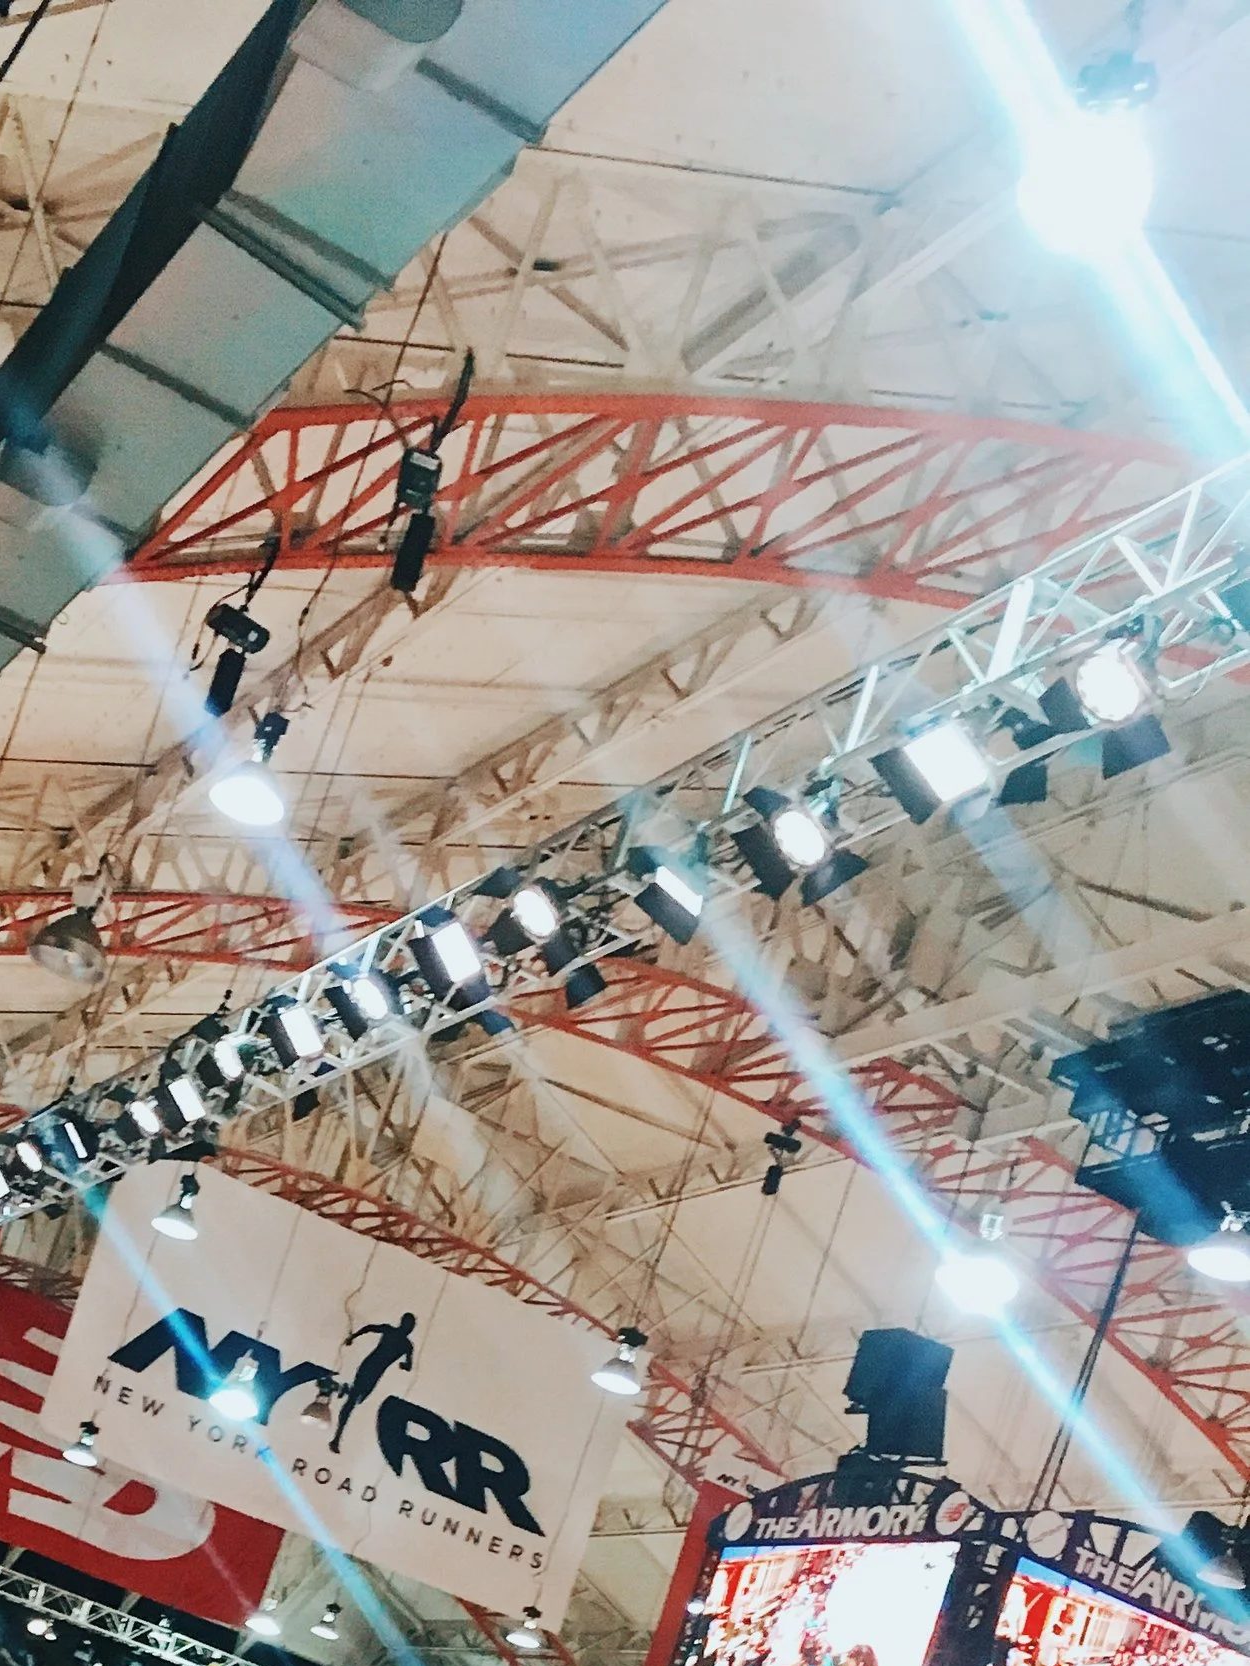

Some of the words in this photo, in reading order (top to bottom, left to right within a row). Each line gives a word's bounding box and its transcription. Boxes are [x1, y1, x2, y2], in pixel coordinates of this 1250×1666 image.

[93, 1375, 165, 1417] NEW
[187, 1414, 271, 1459] YORK
[291, 1457, 377, 1502] ROAD
[399, 1499, 546, 1569] RUNNERS
[376, 1395, 546, 1537] RR
